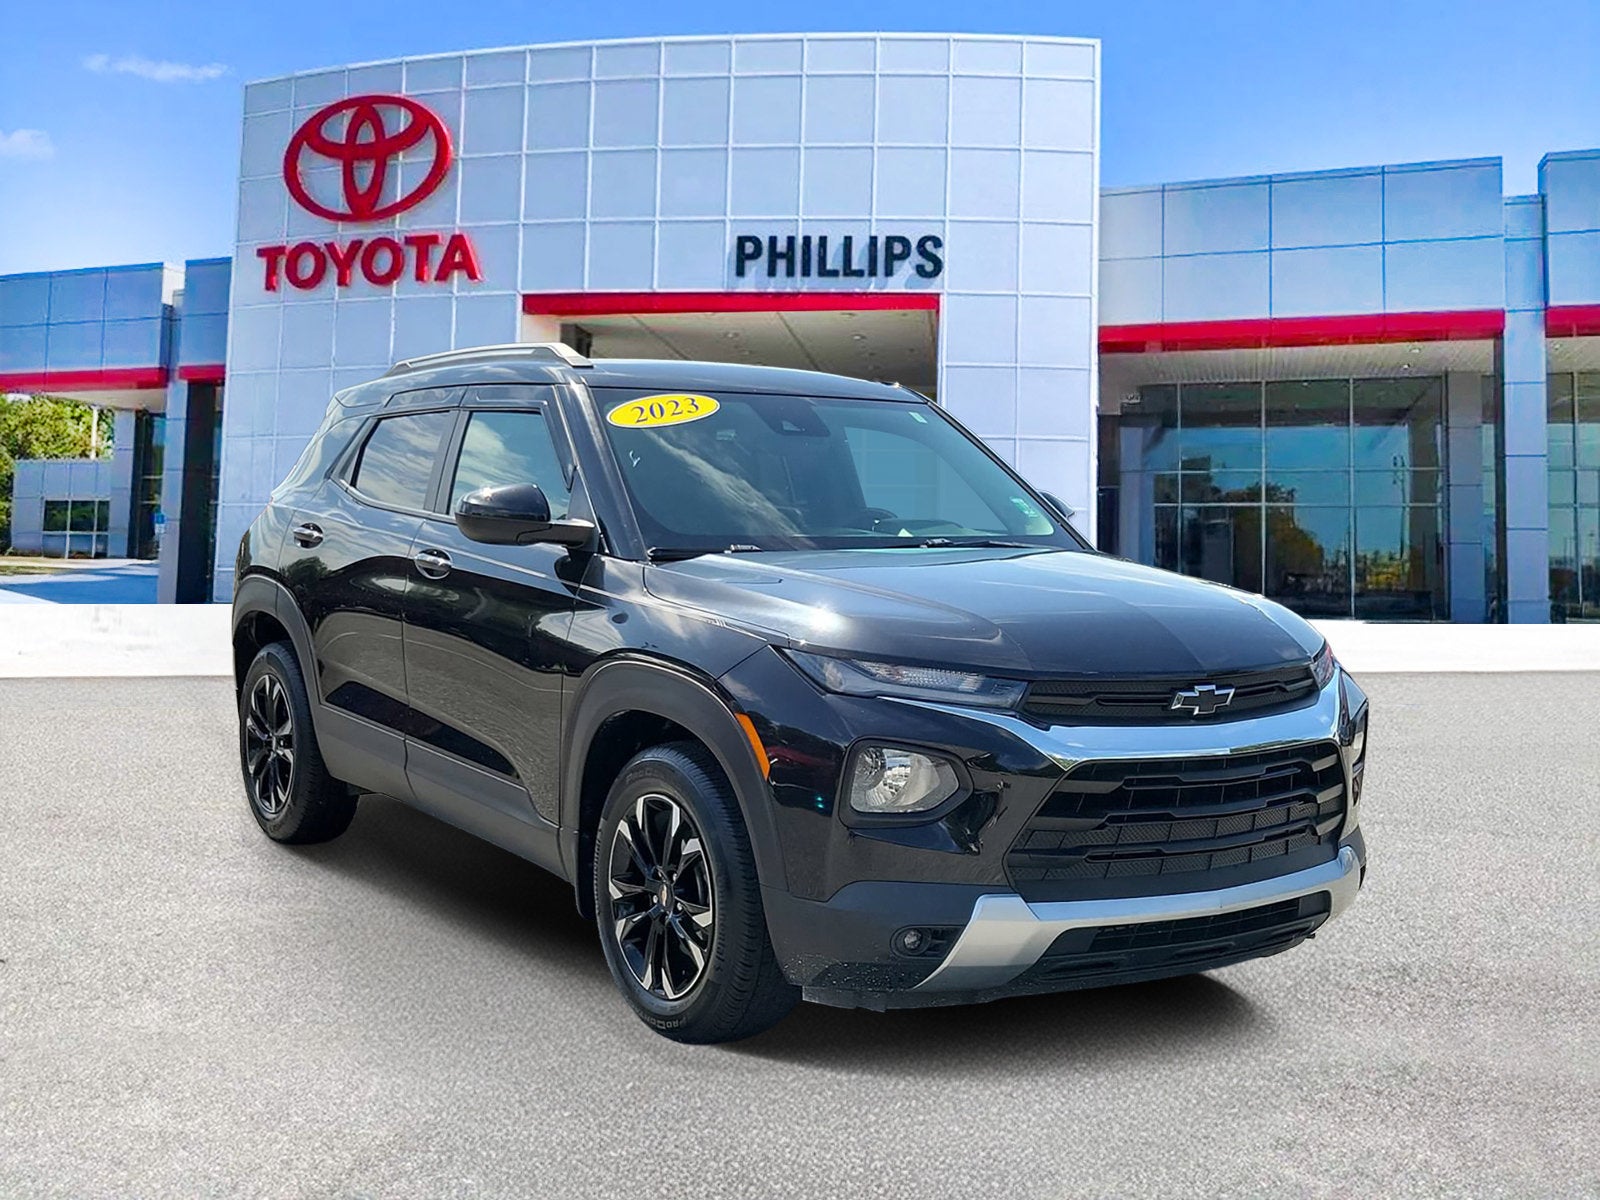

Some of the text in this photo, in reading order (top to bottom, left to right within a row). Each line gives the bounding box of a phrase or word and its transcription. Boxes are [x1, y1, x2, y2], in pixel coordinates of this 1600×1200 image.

[256, 233, 483, 292] TOYOTA
[735, 235, 944, 279] PHILLIPS
[630, 397, 699, 424] 2023
